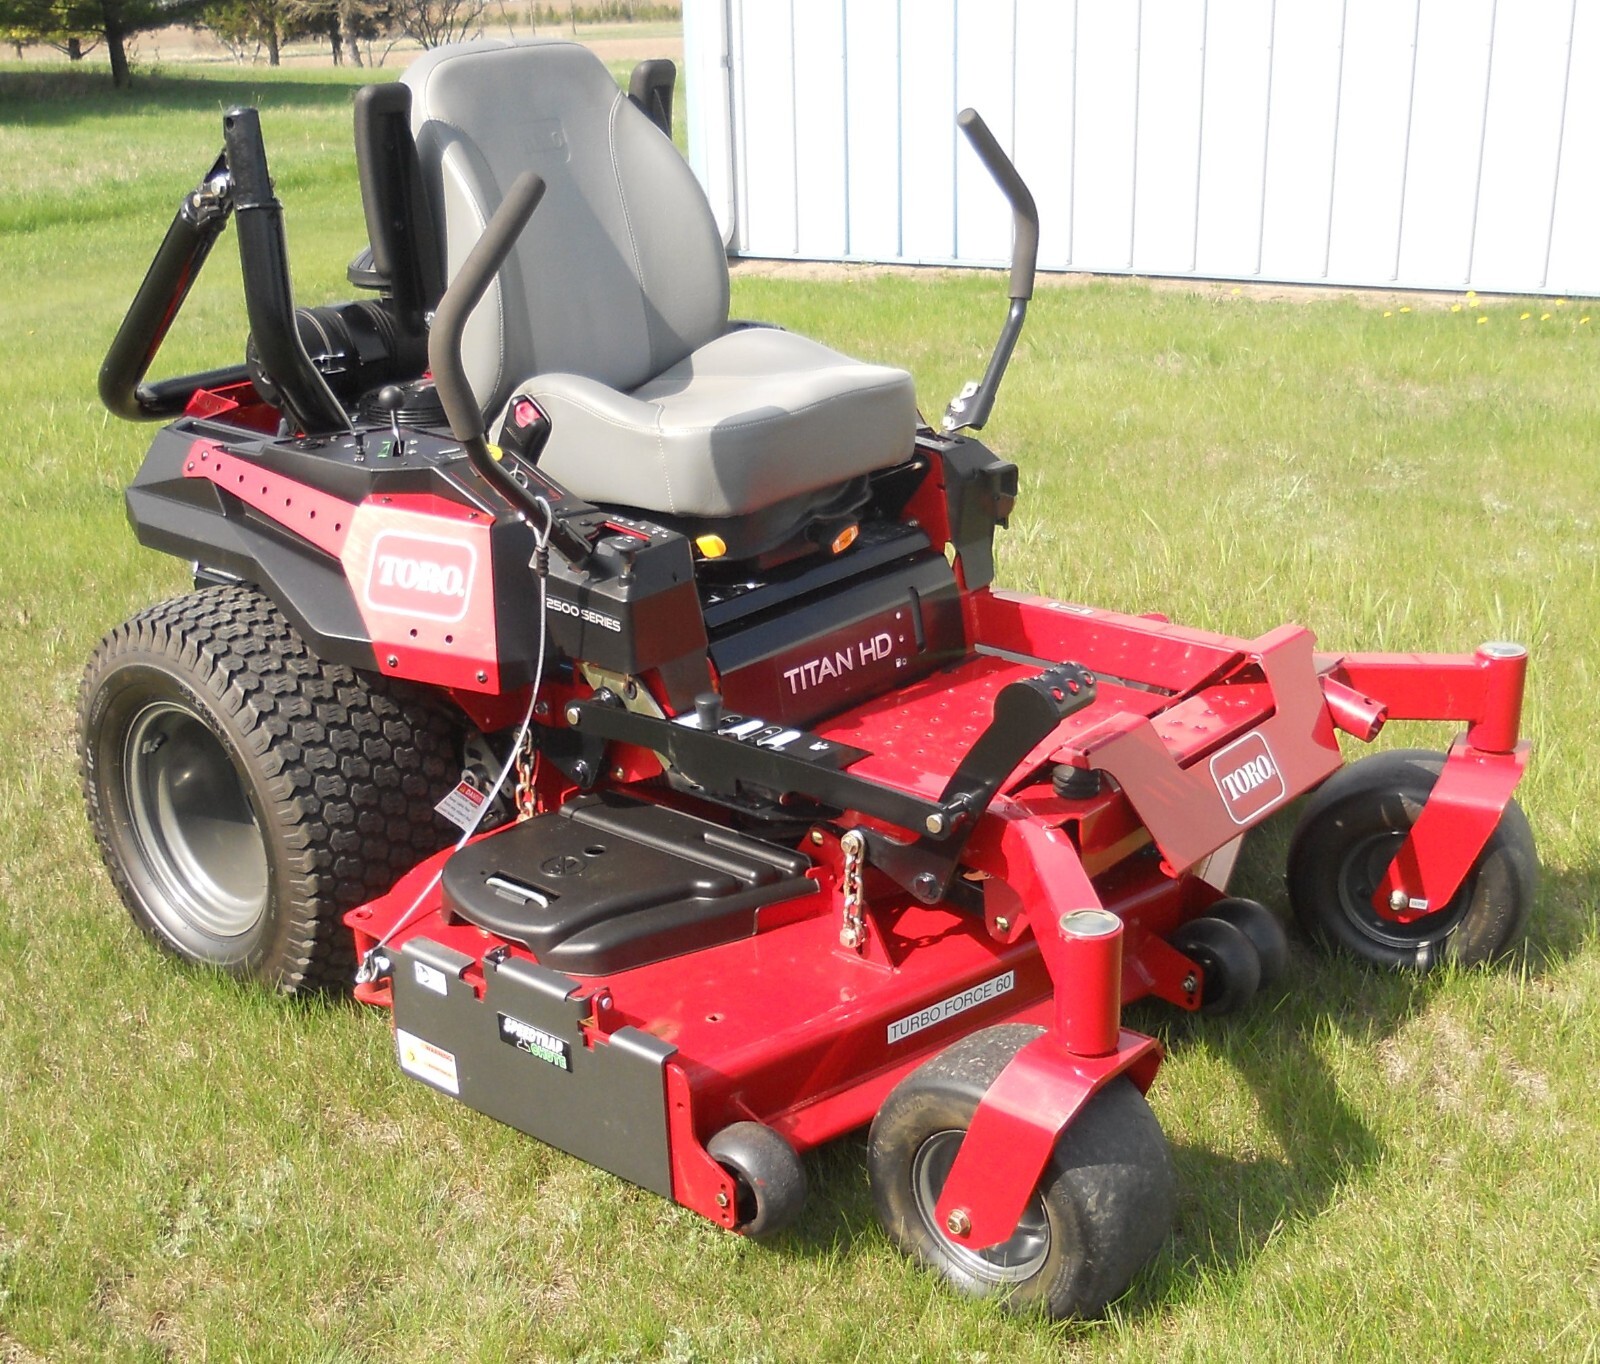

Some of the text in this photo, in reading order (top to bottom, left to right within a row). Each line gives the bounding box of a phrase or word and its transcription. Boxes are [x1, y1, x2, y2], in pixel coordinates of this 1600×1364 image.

[546, 597, 621, 633] 2500 SERIES
[783, 633, 893, 695] TITAN HD
[1221, 754, 1273, 802] TORO
[890, 975, 1011, 1039] TURBO FORCE 60
